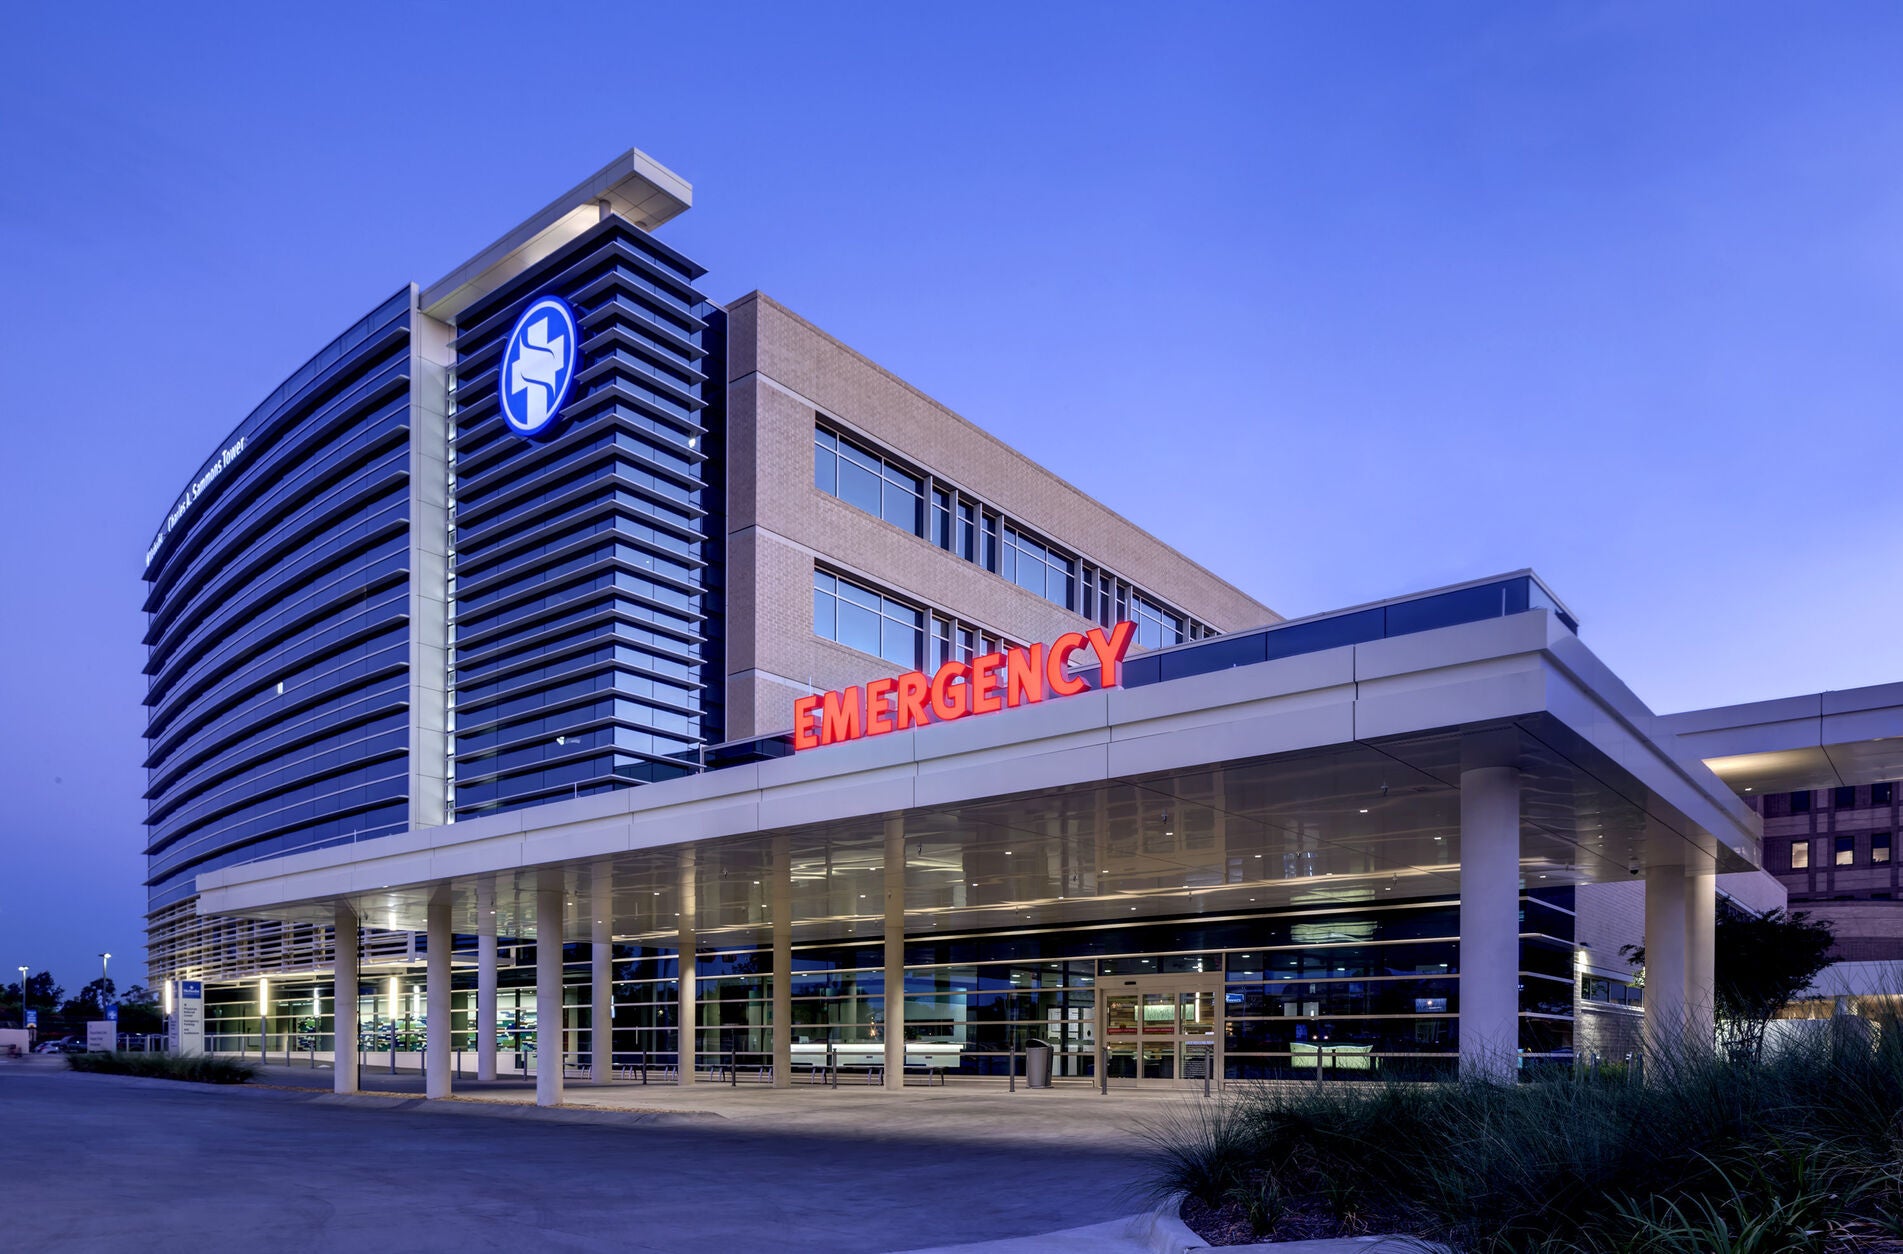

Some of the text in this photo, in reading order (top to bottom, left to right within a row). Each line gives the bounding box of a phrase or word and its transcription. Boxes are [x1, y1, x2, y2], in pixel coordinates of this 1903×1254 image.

[192, 459, 222, 501] Sammons
[222, 437, 246, 468] Tower
[793, 620, 1138, 751] EMERGENCY
